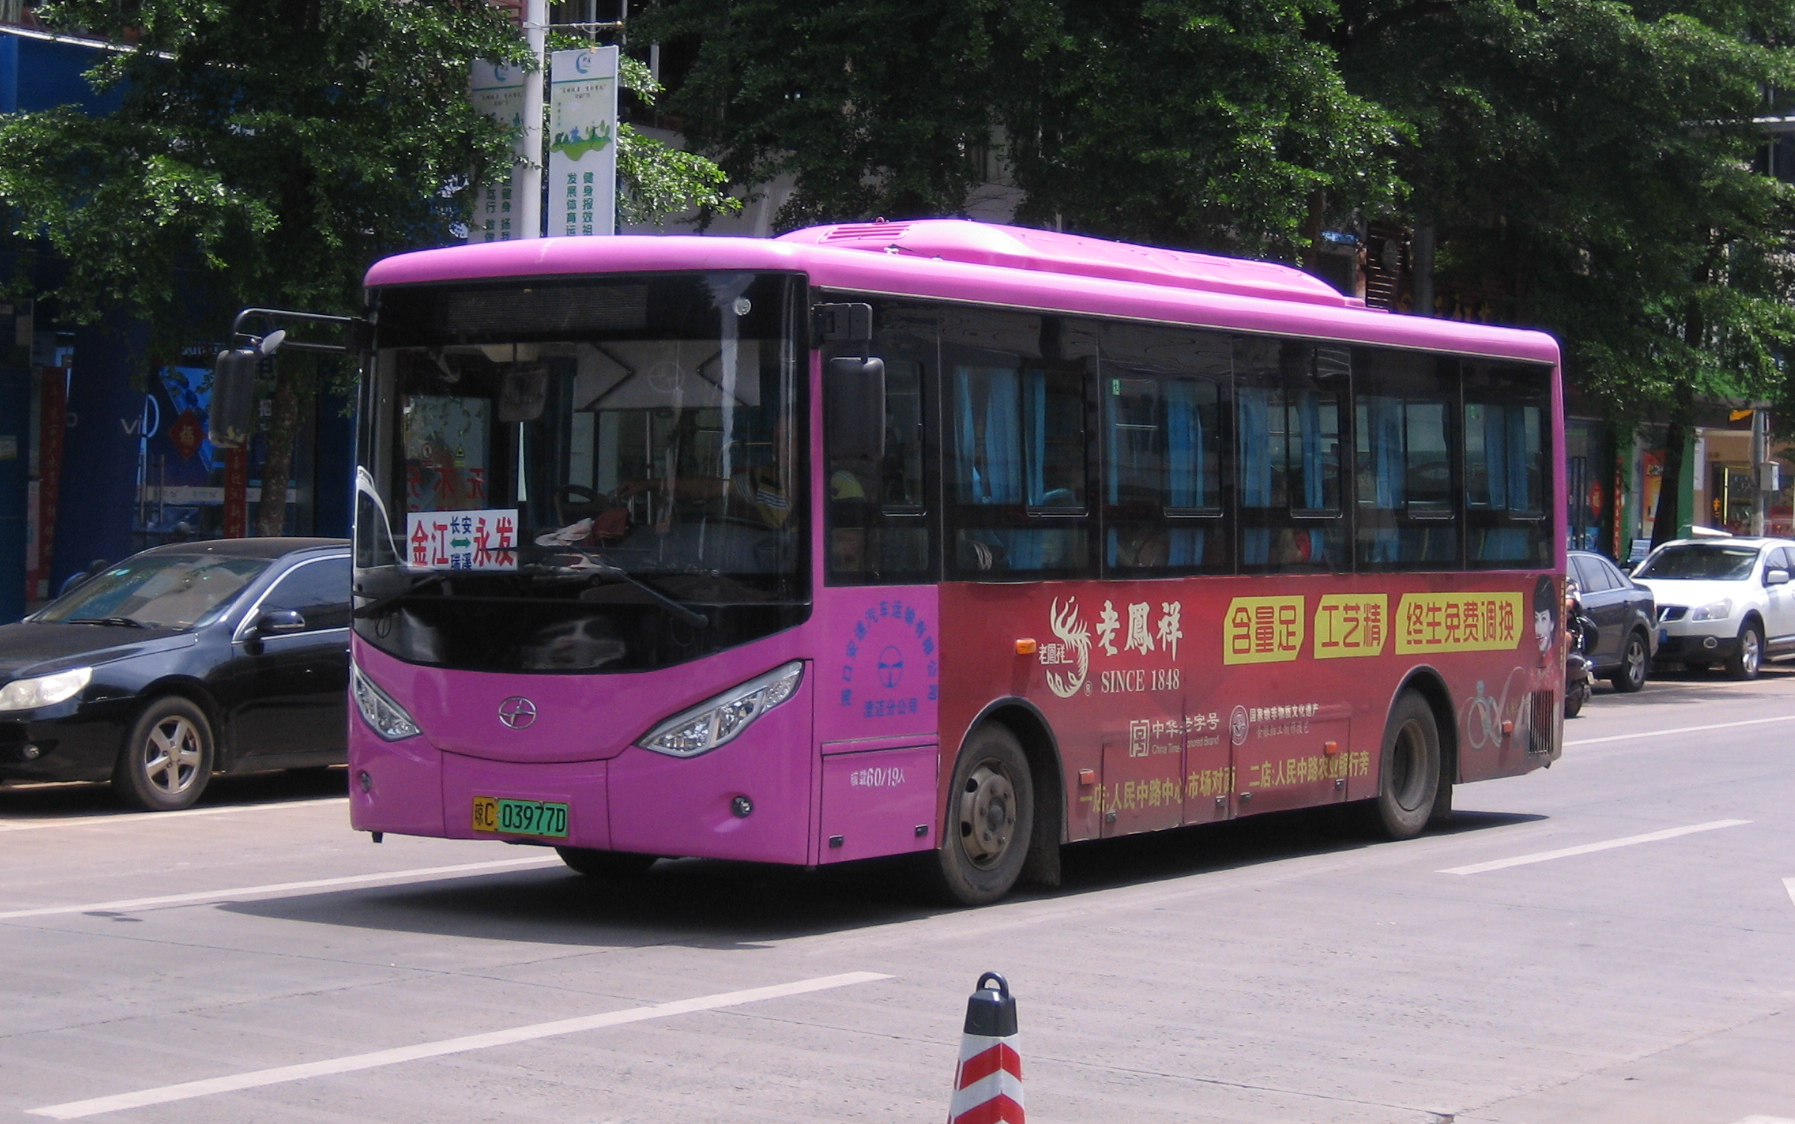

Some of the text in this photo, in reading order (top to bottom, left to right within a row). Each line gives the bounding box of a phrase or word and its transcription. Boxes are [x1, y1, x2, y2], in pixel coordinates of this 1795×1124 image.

[411, 520, 449, 567] 金江
[450, 516, 472, 534] 长安
[473, 516, 514, 567] 永发
[1096, 599, 1183, 662] 老鳳祥
[1232, 604, 1297, 654] 含量足
[1321, 603, 1381, 648] 工艺精
[1406, 600, 1514, 645] 终生免费调换
[1101, 668, 1180, 693] SINCE 1848
[1152, 712, 1220, 739] 中华老字号
[502, 803, 566, 833] 03977D
